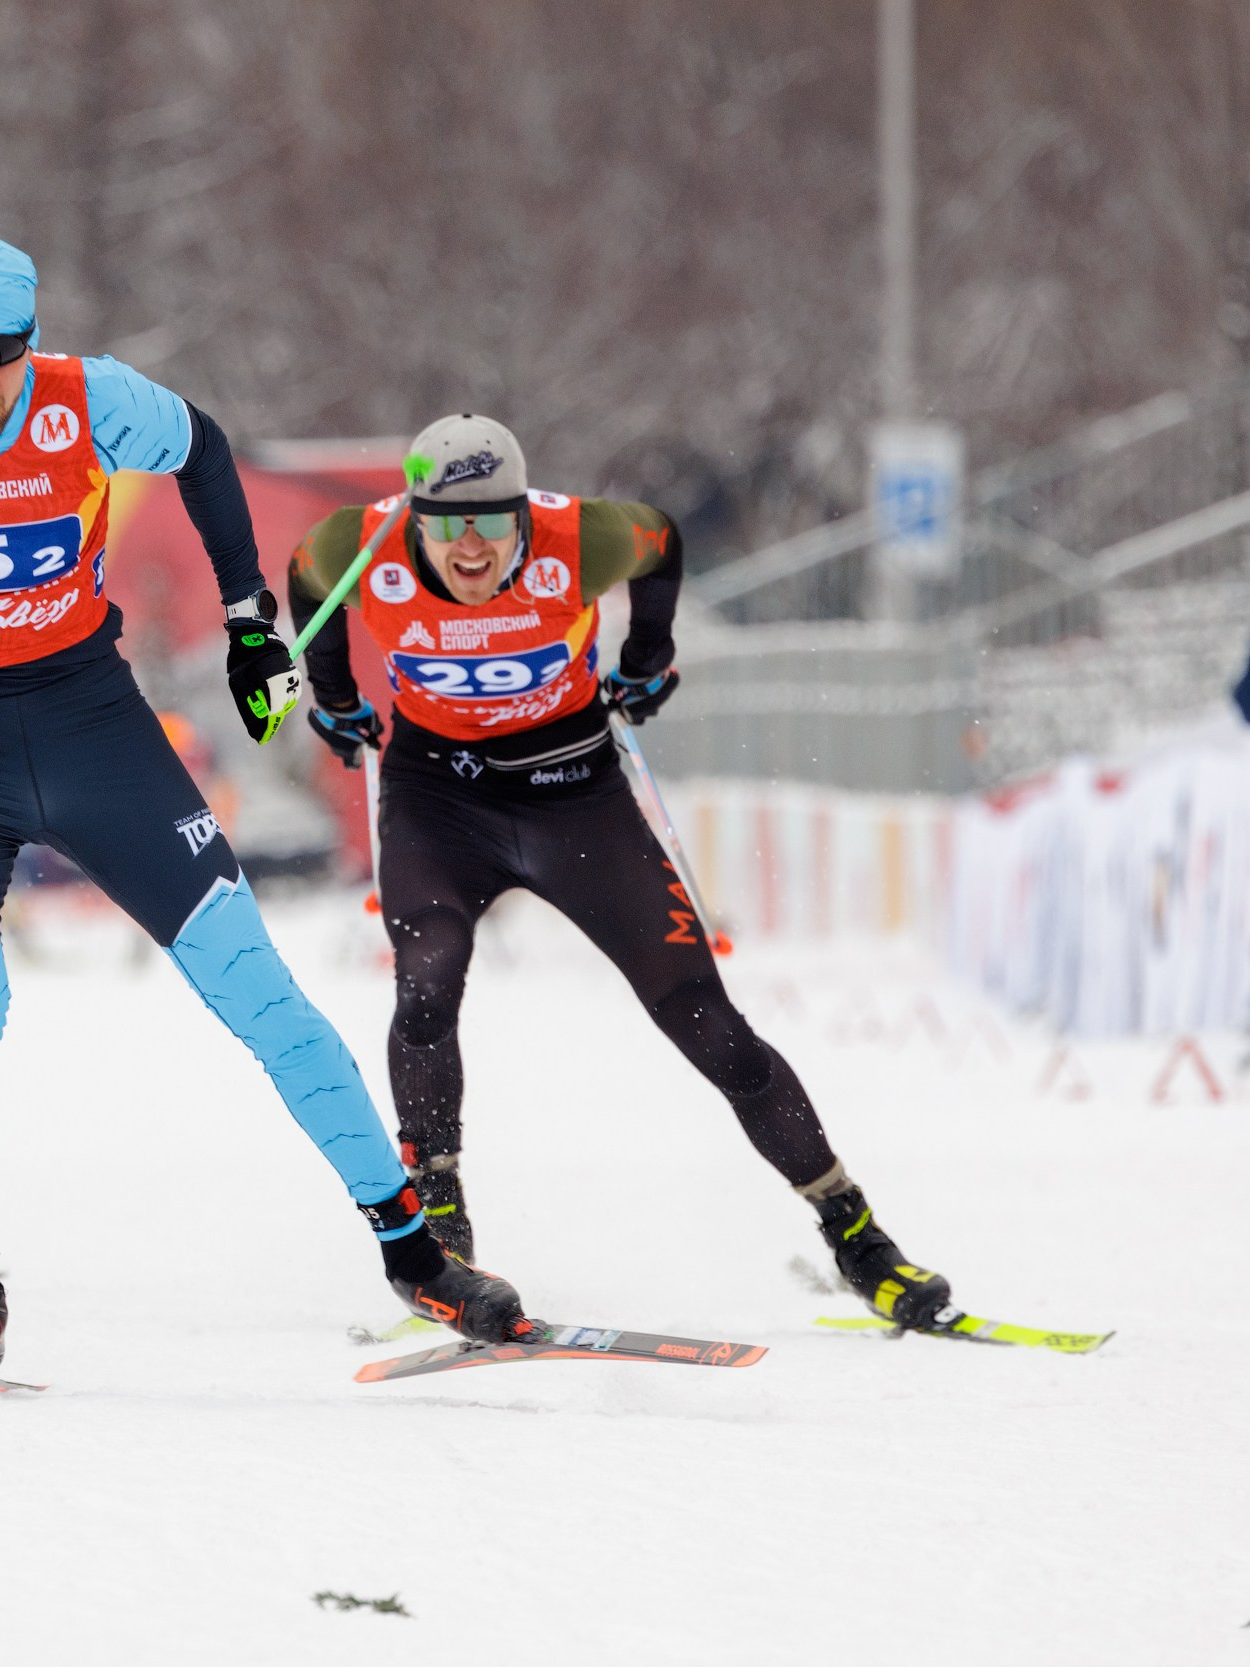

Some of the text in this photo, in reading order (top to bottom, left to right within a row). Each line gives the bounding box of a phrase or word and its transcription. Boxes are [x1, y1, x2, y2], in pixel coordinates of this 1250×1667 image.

[32, 545, 66, 577] 2
[438, 610, 542, 635] МОСКОВСКИЙ
[440, 633, 490, 651] СПОРТ
[416, 659, 533, 694] 29
